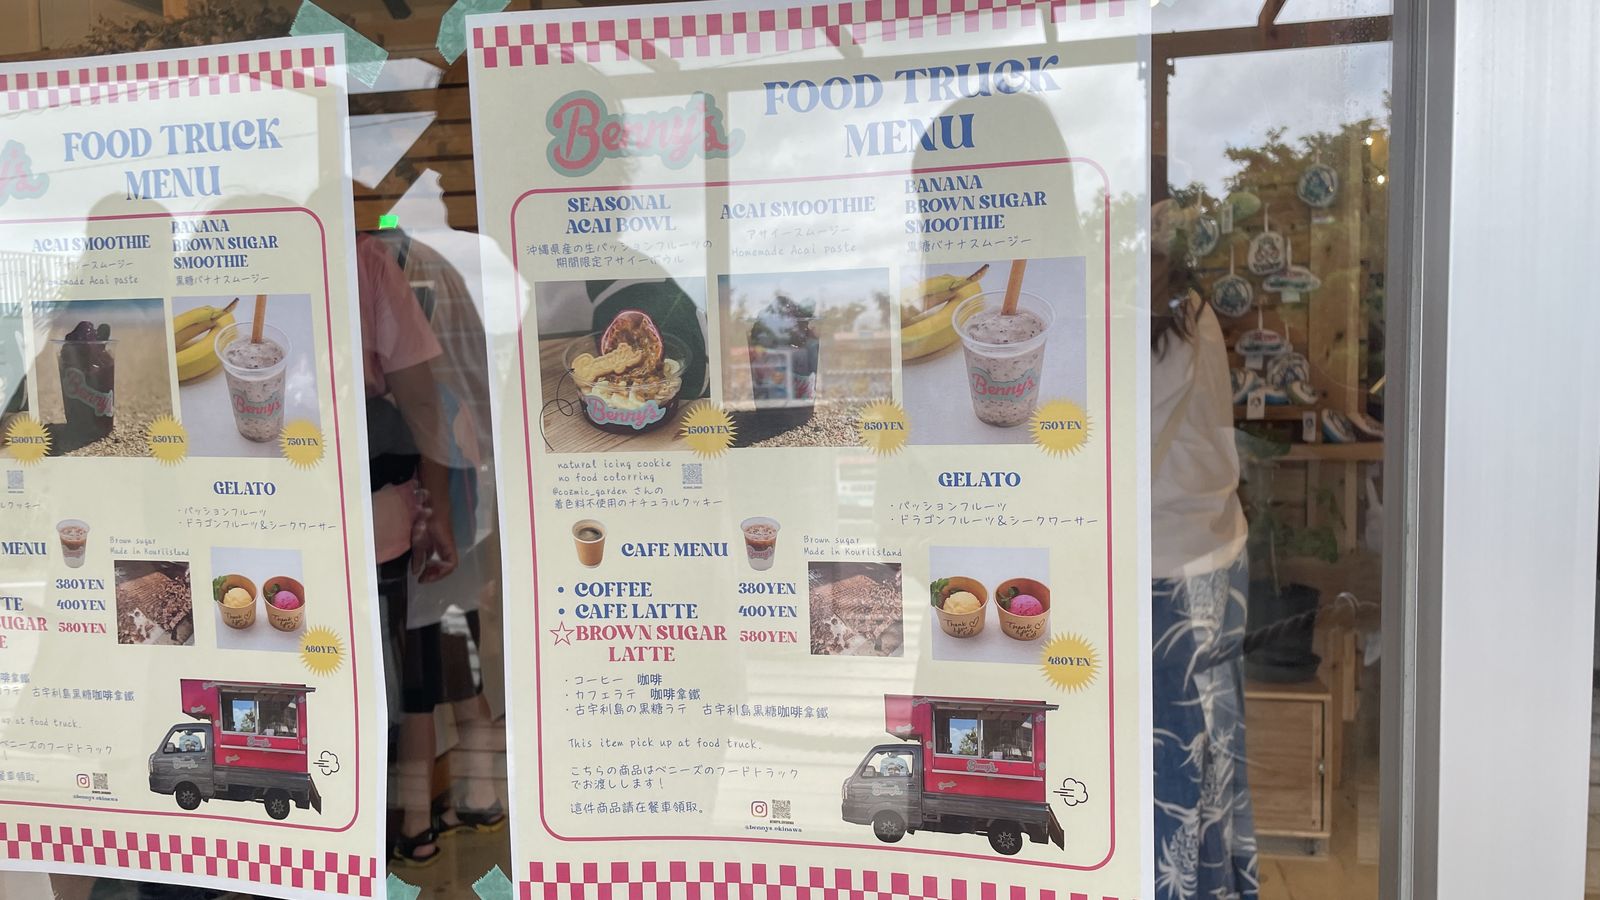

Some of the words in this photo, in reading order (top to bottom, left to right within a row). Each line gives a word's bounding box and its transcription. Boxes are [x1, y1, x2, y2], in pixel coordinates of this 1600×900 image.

[763, 73, 883, 116] FOOD
[895, 55, 1062, 104] TRUCK
[63, 127, 152, 162] FOOD
[160, 117, 283, 155] TRUCK
[548, 93, 742, 173] Benny's
[844, 113, 976, 158] MENU
[125, 165, 222, 200] MENU
[905, 174, 983, 194] BANANA
[567, 194, 672, 213] SEASONAL
[720, 202, 766, 220] ACAI
[770, 196, 876, 217] SMOOTHIE
[905, 195, 975, 214] BROWN
[978, 191, 1048, 209] SUGAR
[171, 219, 230, 234] BANANA
[565, 217, 612, 234] ACAI
[616, 215, 676, 233] BOWL
[905, 214, 1006, 234] SMOOTHIE
[32, 238, 69, 252] ACAI
[71, 235, 151, 251] SMOOTHIE
[172, 237, 225, 252] BROWN
[227, 235, 279, 250] SUGAR
[731, 246, 785, 257] Homemade
[824, 244, 857, 256] paste
[173, 254, 249, 269] SMOOTHIE
[89, 275, 110, 285] Acai
[114, 275, 139, 286] paste
[971, 373, 1037, 396] Benny's
[233, 395, 282, 414] Benny's
[589, 398, 660, 428] Benny's
[687, 425, 731, 434] 1500YEN
[863, 421, 904, 431] 850YEN
[1039, 420, 1082, 431] 750YEN
[152, 435, 185, 443] 850YEN
[286, 437, 319, 446] 750YEN
[557, 459, 597, 469] natural
[604, 459, 632, 470] icing
[637, 458, 672, 467] cookie
[576, 473, 597, 482] food
[937, 472, 1021, 488] GELATO
[213, 481, 276, 496] GELATO
[634, 487, 664, 495] さんの
[554, 498, 723, 509] 着色料不使用のナチュラルクッキー
[109, 536, 131, 544] Brown
[135, 538, 156, 546] sugar
[803, 535, 830, 544] Brown
[835, 537, 860, 545] sugar
[1, 541, 47, 555] MENU
[621, 542, 670, 557] CAFE
[673, 542, 728, 557] MENU
[803, 547, 825, 556] Made
[56, 578, 104, 590] 380YEN
[574, 582, 653, 598] COFFEE
[738, 582, 796, 595] 380YEN
[56, 599, 106, 611] 400YEN
[575, 603, 628, 619] CAFE
[631, 603, 698, 619] LATTE
[738, 605, 797, 618] 400YEN
[0, 616, 48, 631] UGAR
[58, 621, 107, 634] 580YEN
[575, 625, 652, 641] BROWN
[656, 625, 727, 641] SUGAR
[739, 630, 798, 643] 580YEN
[305, 645, 338, 654] 480YEN
[608, 646, 675, 662] LATTE
[1047, 656, 1091, 667] 480YEN
[574, 675, 623, 685] コーヒー
[637, 673, 663, 686] 咖啡
[575, 689, 636, 700] カフェラテ
[650, 688, 701, 701] 咖啡拿鐵
[575, 703, 687, 716] 古宇利島の黒糖ラテ
[30, 717, 49, 726] food
[568, 738, 592, 748] This
[600, 739, 624, 747] item
[630, 738, 653, 749] pick
[659, 740, 673, 749] up
[678, 739, 690, 748] at
[696, 738, 720, 748] food
[727, 738, 762, 750] truck.
[571, 764, 799, 779] こちらの商品はベニーズのフードトラック
[571, 777, 664, 790] でお渡しします！
[570, 800, 704, 815] 這件商品請在餐車領取。
